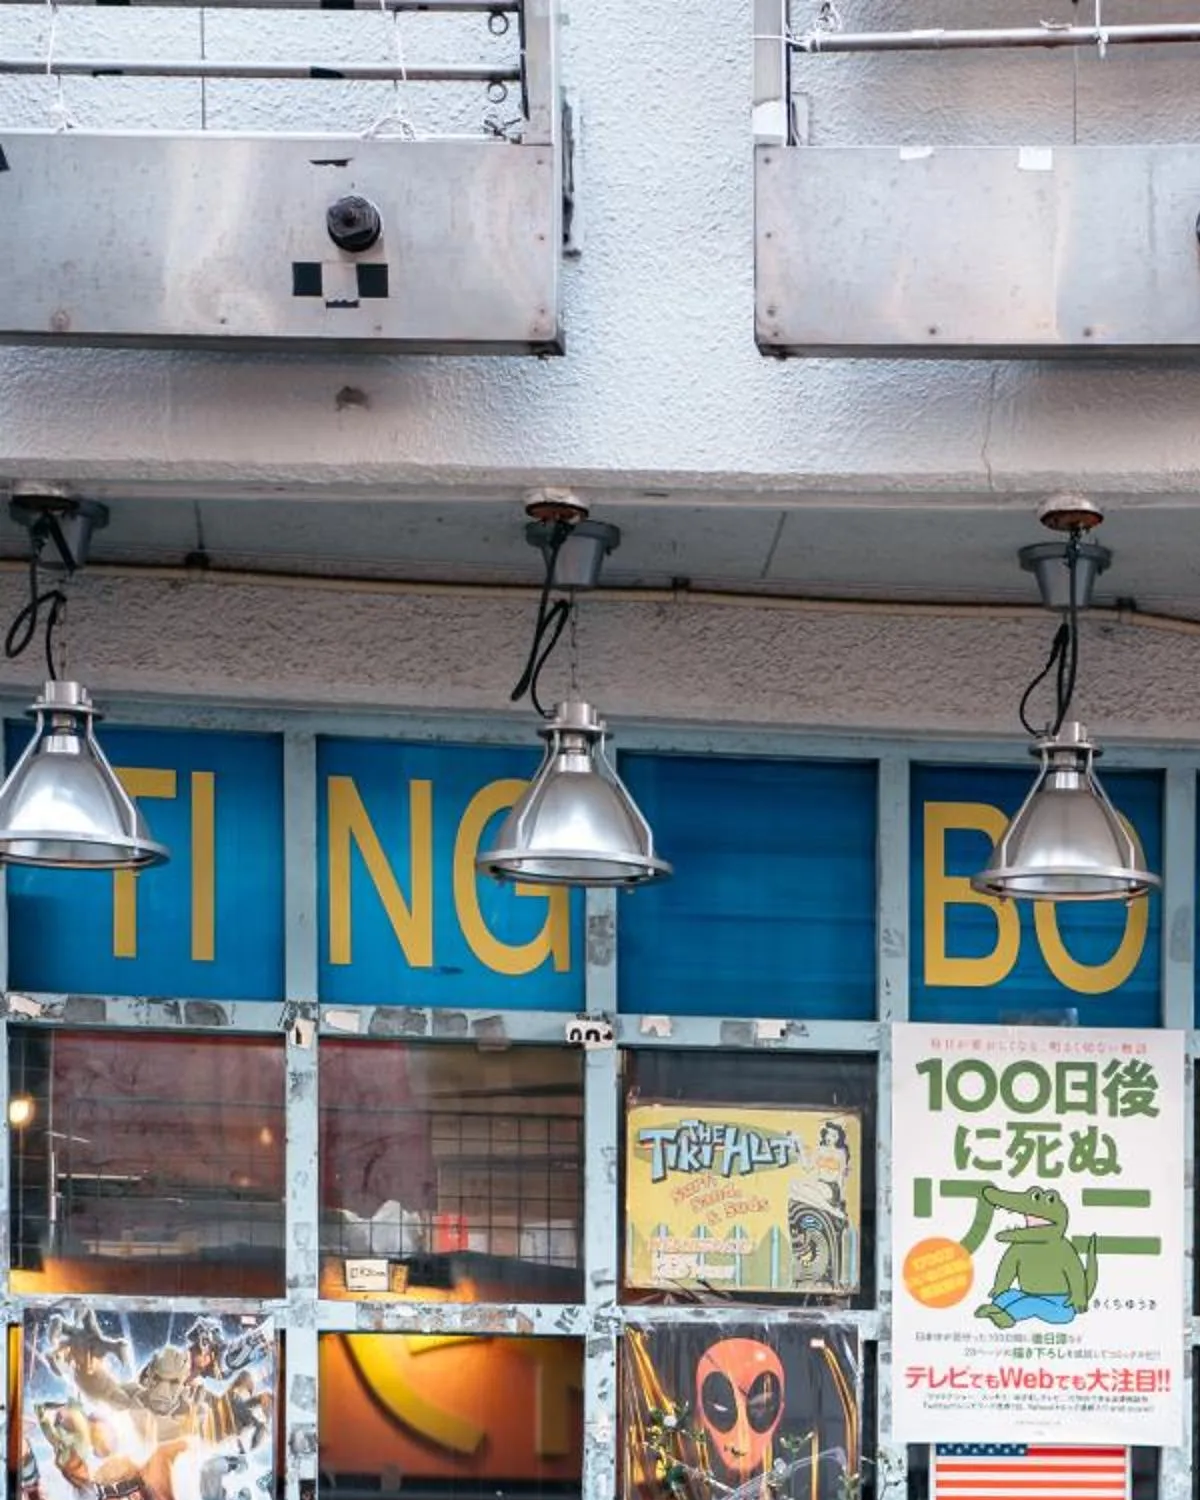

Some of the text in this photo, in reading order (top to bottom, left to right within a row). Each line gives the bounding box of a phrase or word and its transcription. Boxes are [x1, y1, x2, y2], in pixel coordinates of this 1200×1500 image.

[915, 1058, 1161, 1118] 100日後
[680, 1119, 727, 1144] THE
[720, 1126, 794, 1179] HUT
[953, 1121, 1122, 1179] に死ぬ
[913, 1177, 1162, 1256] ワニ
